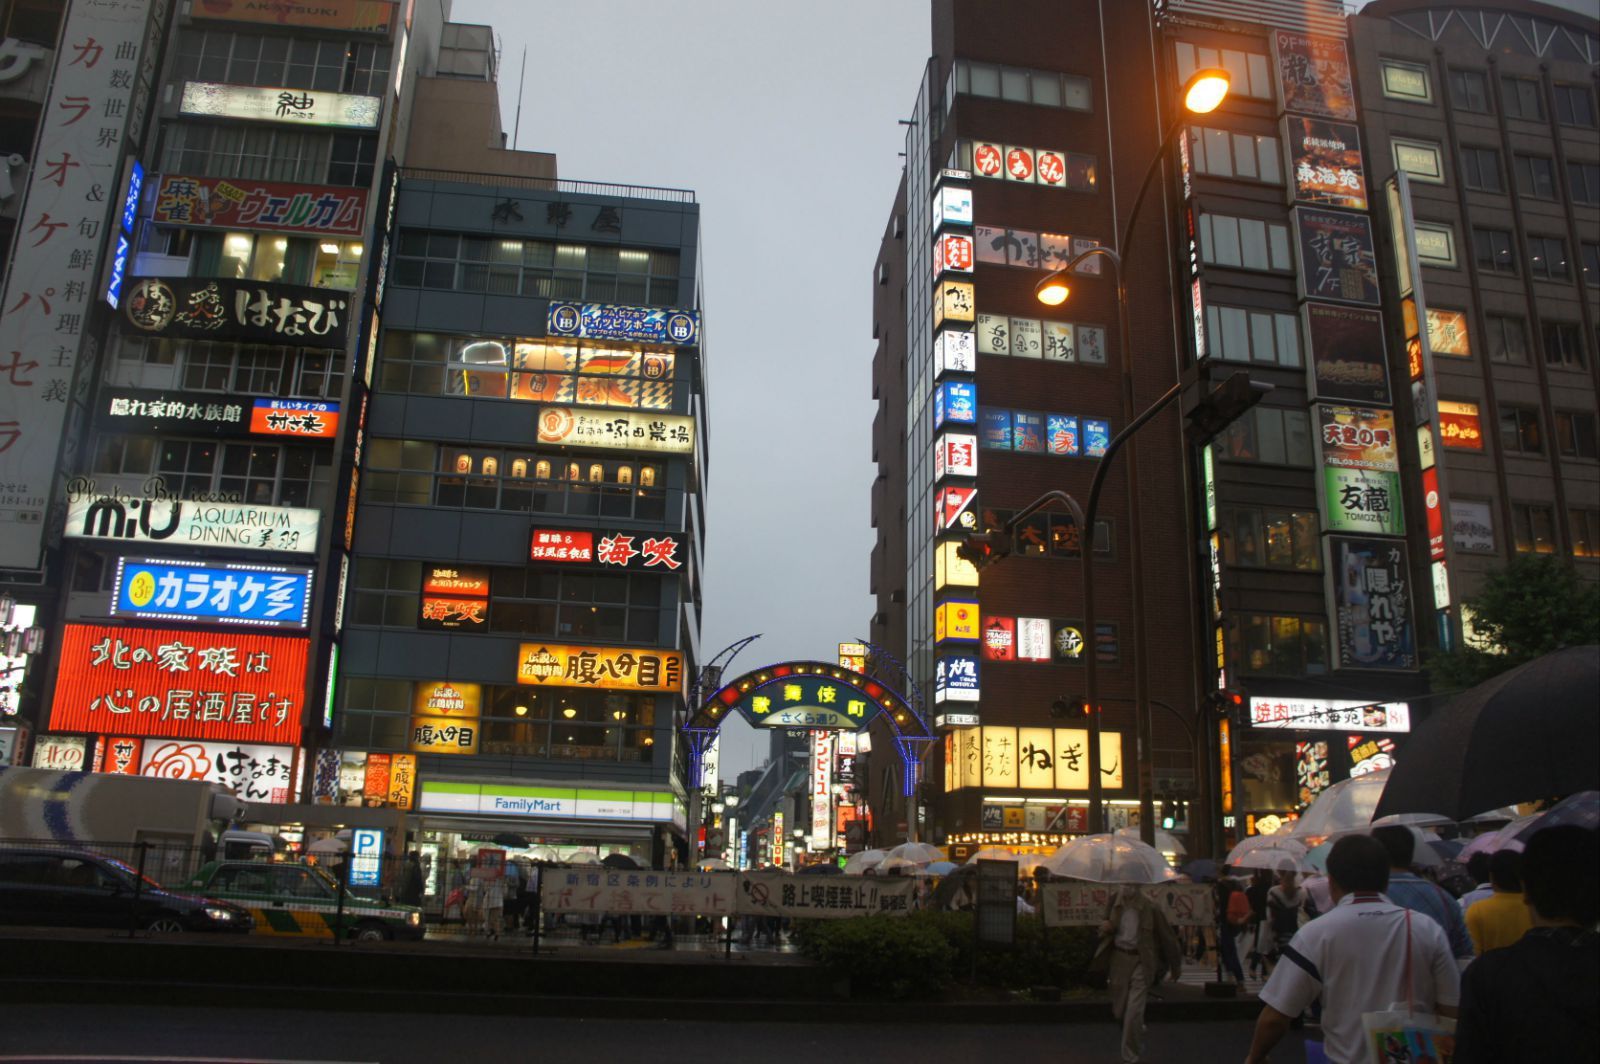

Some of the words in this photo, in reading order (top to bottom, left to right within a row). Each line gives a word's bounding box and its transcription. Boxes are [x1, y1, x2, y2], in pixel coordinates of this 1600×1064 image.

[1297, 164, 1361, 190] 東海苑
[160, 178, 198, 222] 麻雀
[976, 227, 991, 237] 7F
[234, 290, 347, 336] はなび
[978, 316, 991, 324] 6F
[110, 398, 243, 423] 隠れ家的水族館
[270, 400, 328, 412] 新しいタイプの
[1323, 423, 1392, 449] 天空の雫
[1339, 484, 1391, 514] 友蔵
[192, 507, 292, 529] AQUARIUM
[1344, 511, 1390, 524] TOMOZOU
[189, 523, 252, 545] DINING
[597, 532, 683, 570] 海峡
[133, 576, 152, 600] 3F
[155, 570, 266, 613] カラオケ
[423, 600, 485, 624] 海峡
[1364, 567, 1394, 645] 隠れや
[91, 638, 272, 678] 北の家族は
[564, 650, 662, 687] 腹八分目
[90, 689, 294, 727] 心の居酒屋です
[752, 684, 866, 718] 歌舞伎町
[1254, 702, 1289, 722] 焼肉
[780, 712, 839, 725] さくら通り
[413, 725, 474, 747] 腹八分目
[42, 744, 83, 765] 北の
[111, 739, 136, 775] 村さ
[216, 745, 291, 781] はなまる
[984, 736, 994, 776] とろろ
[999, 735, 1012, 777] 牛たん
[494, 796, 561, 813] FamilyMart
[358, 834, 375, 855] P
[566, 874, 713, 888] 新宿区条例により
[549, 889, 727, 912] ポイ捨て禁止
